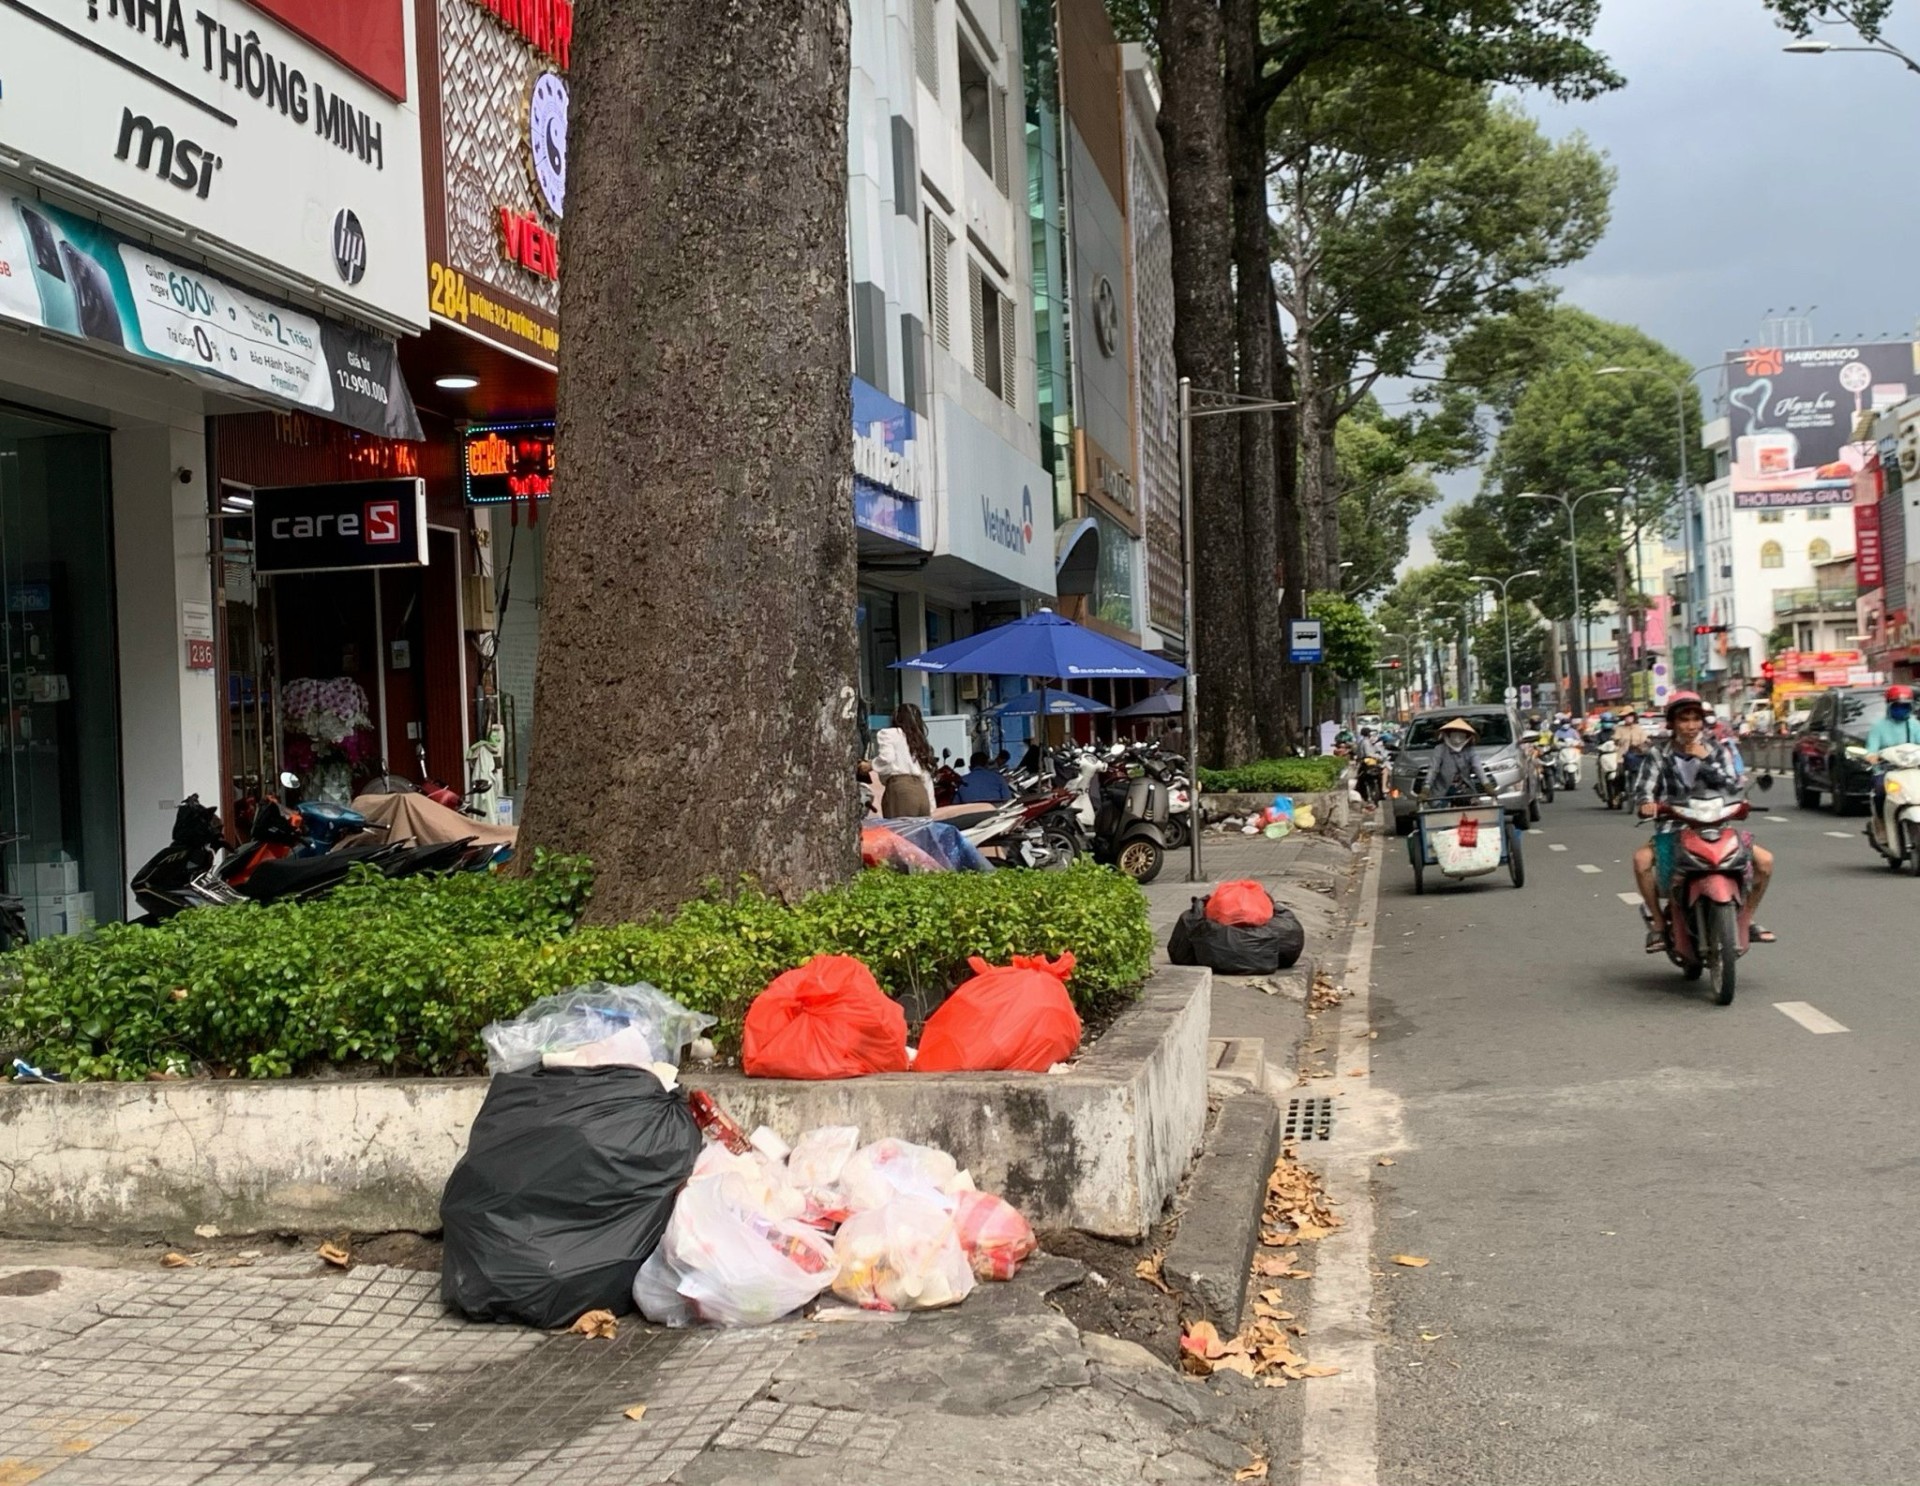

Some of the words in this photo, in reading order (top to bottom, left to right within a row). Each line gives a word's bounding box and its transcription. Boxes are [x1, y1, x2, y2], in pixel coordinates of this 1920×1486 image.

[196, 10, 308, 124] THÔNG
[313, 82, 384, 171] MINH
[114, 106, 218, 200] msi
[431, 262, 468, 323] 284
[269, 313, 289, 346] 2
[271, 513, 359, 539] care
[192, 645, 212, 663] 286
